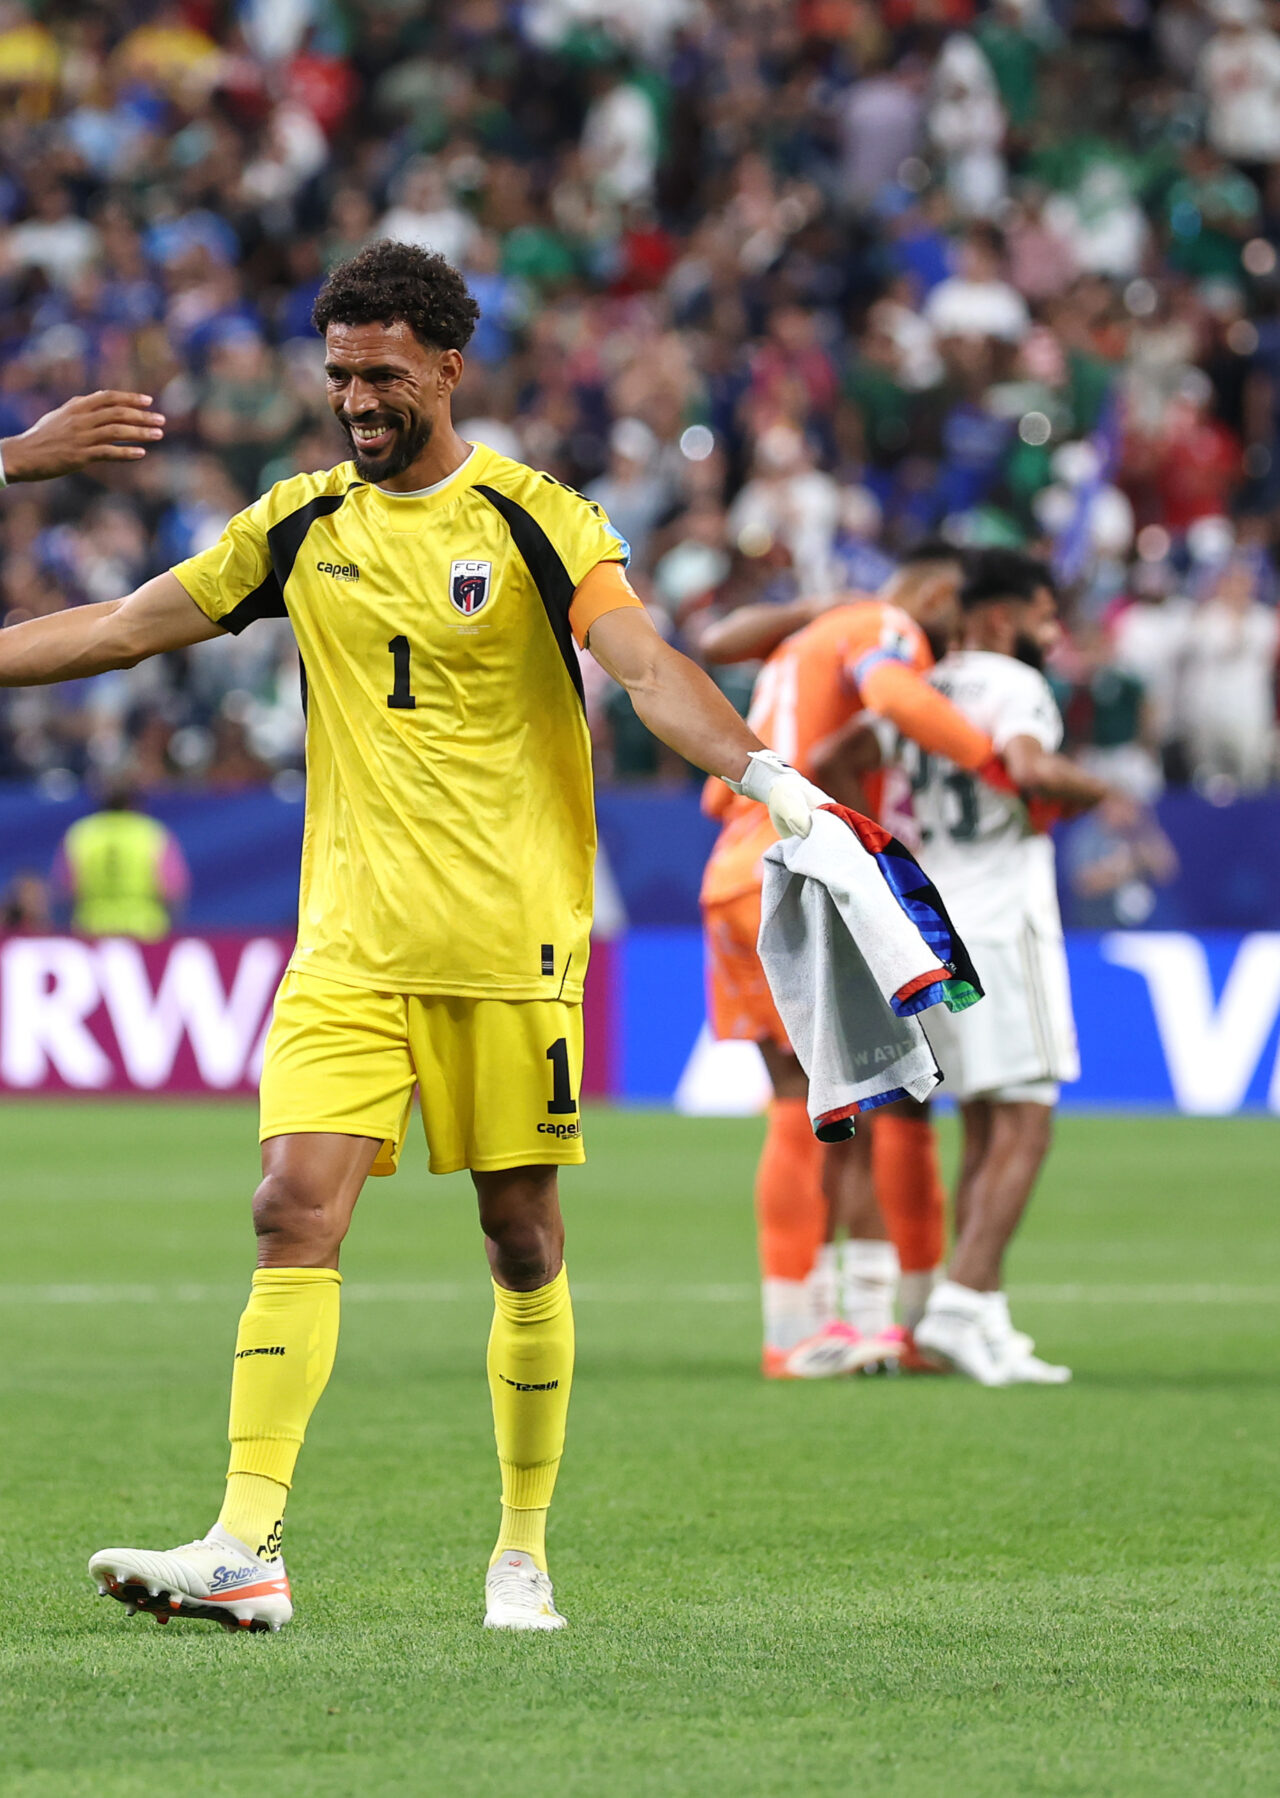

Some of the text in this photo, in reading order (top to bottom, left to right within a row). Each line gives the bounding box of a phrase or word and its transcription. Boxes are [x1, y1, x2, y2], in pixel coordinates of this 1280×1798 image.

[316, 561, 360, 578] capelli
[454, 562, 488, 571] FCF
[387, 634, 417, 709] 1
[1100, 930, 1280, 1117] V
[546, 1037, 577, 1114] 1
[536, 1118, 581, 1138] capel
